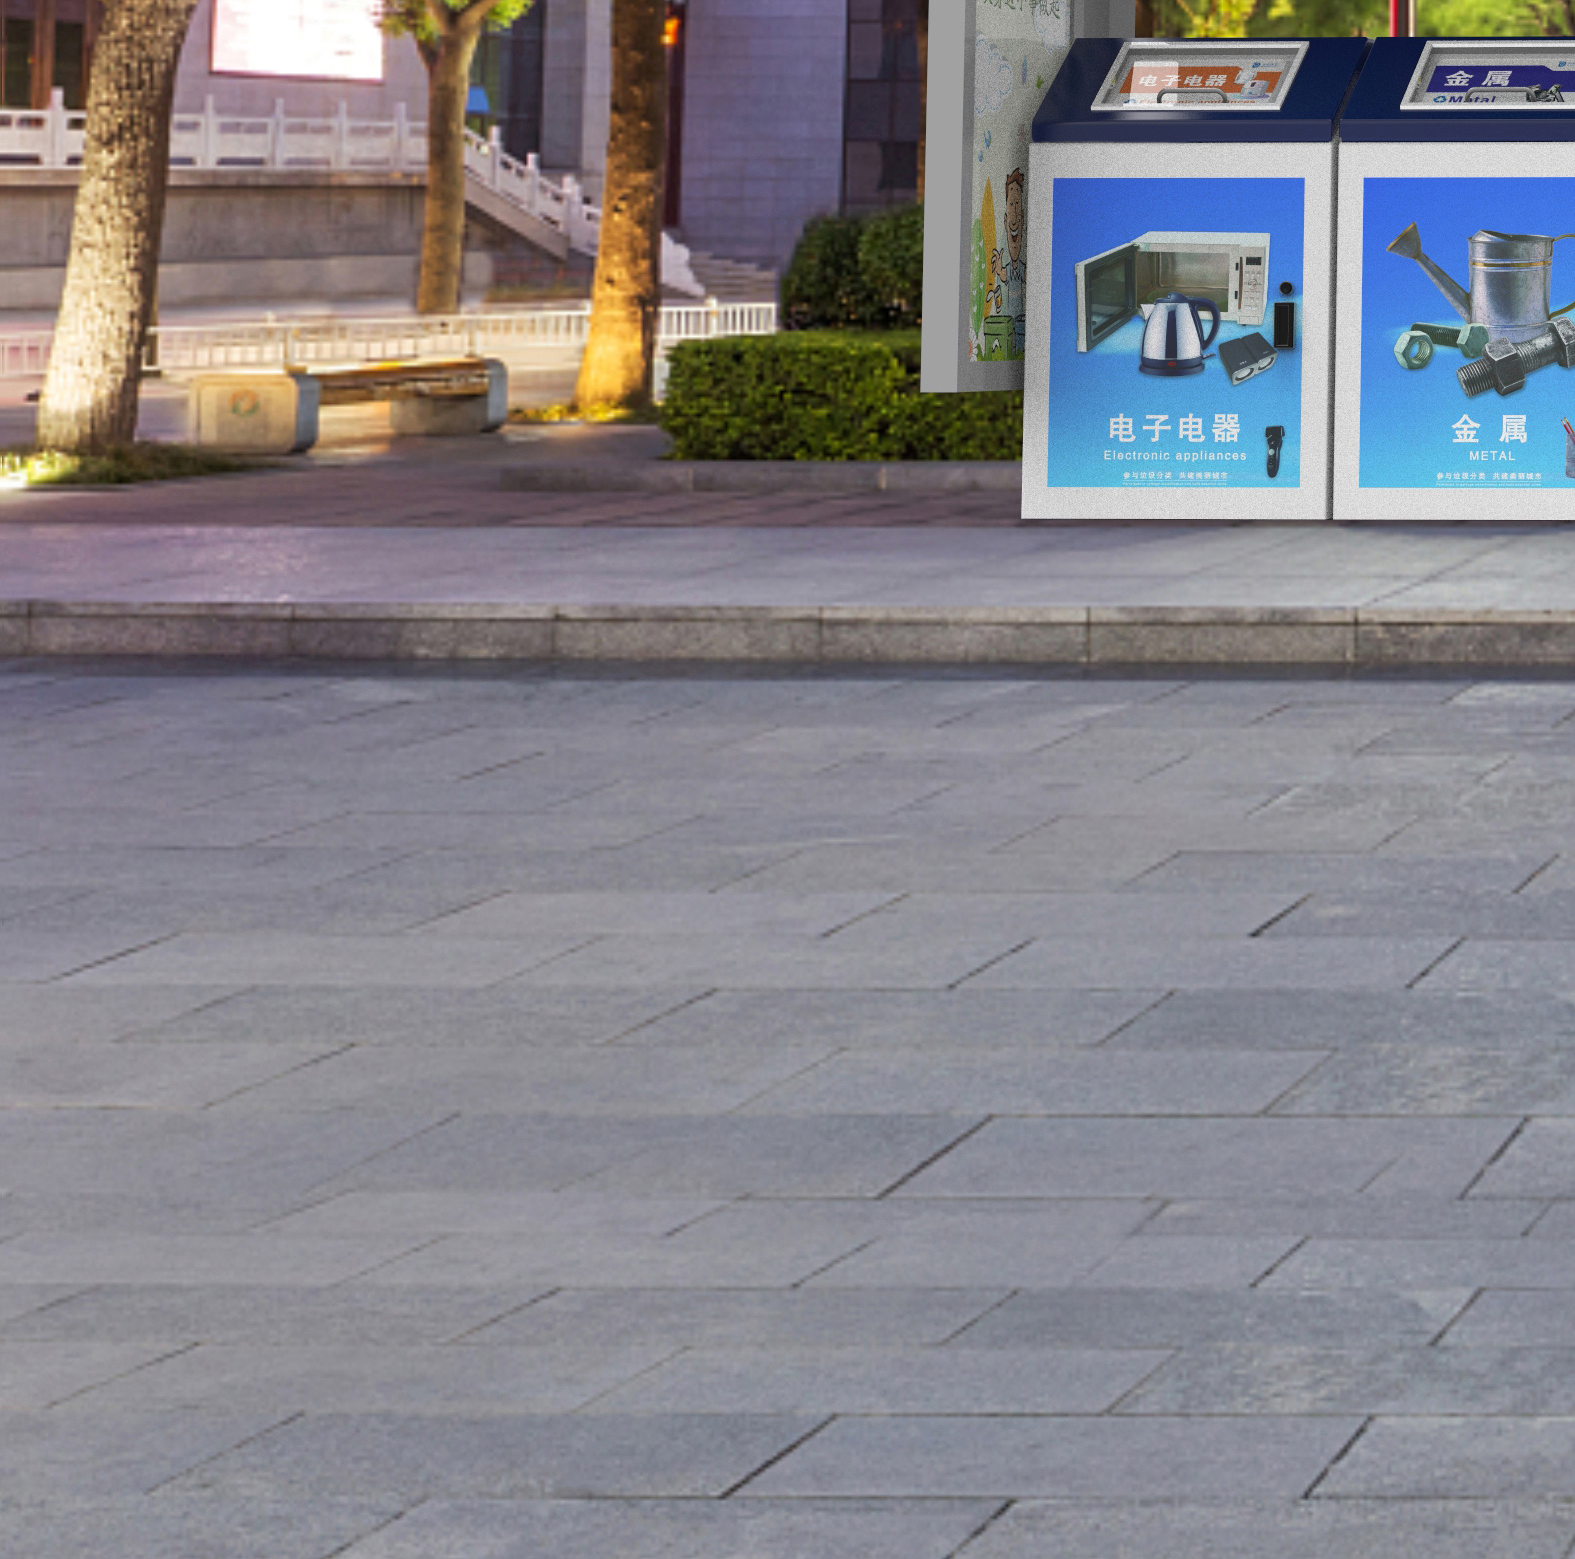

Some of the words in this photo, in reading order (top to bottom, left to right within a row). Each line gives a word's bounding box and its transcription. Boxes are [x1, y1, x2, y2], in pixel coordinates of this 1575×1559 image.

[1138, 74, 1228, 87] 电子电器
[1443, 70, 1513, 87] 金属
[1109, 413, 1241, 443] 电子电器
[1451, 413, 1528, 444] 金属
[1103, 449, 1171, 462] Electronic
[1175, 449, 1247, 464] appliances
[1469, 450, 1516, 461] METAL
